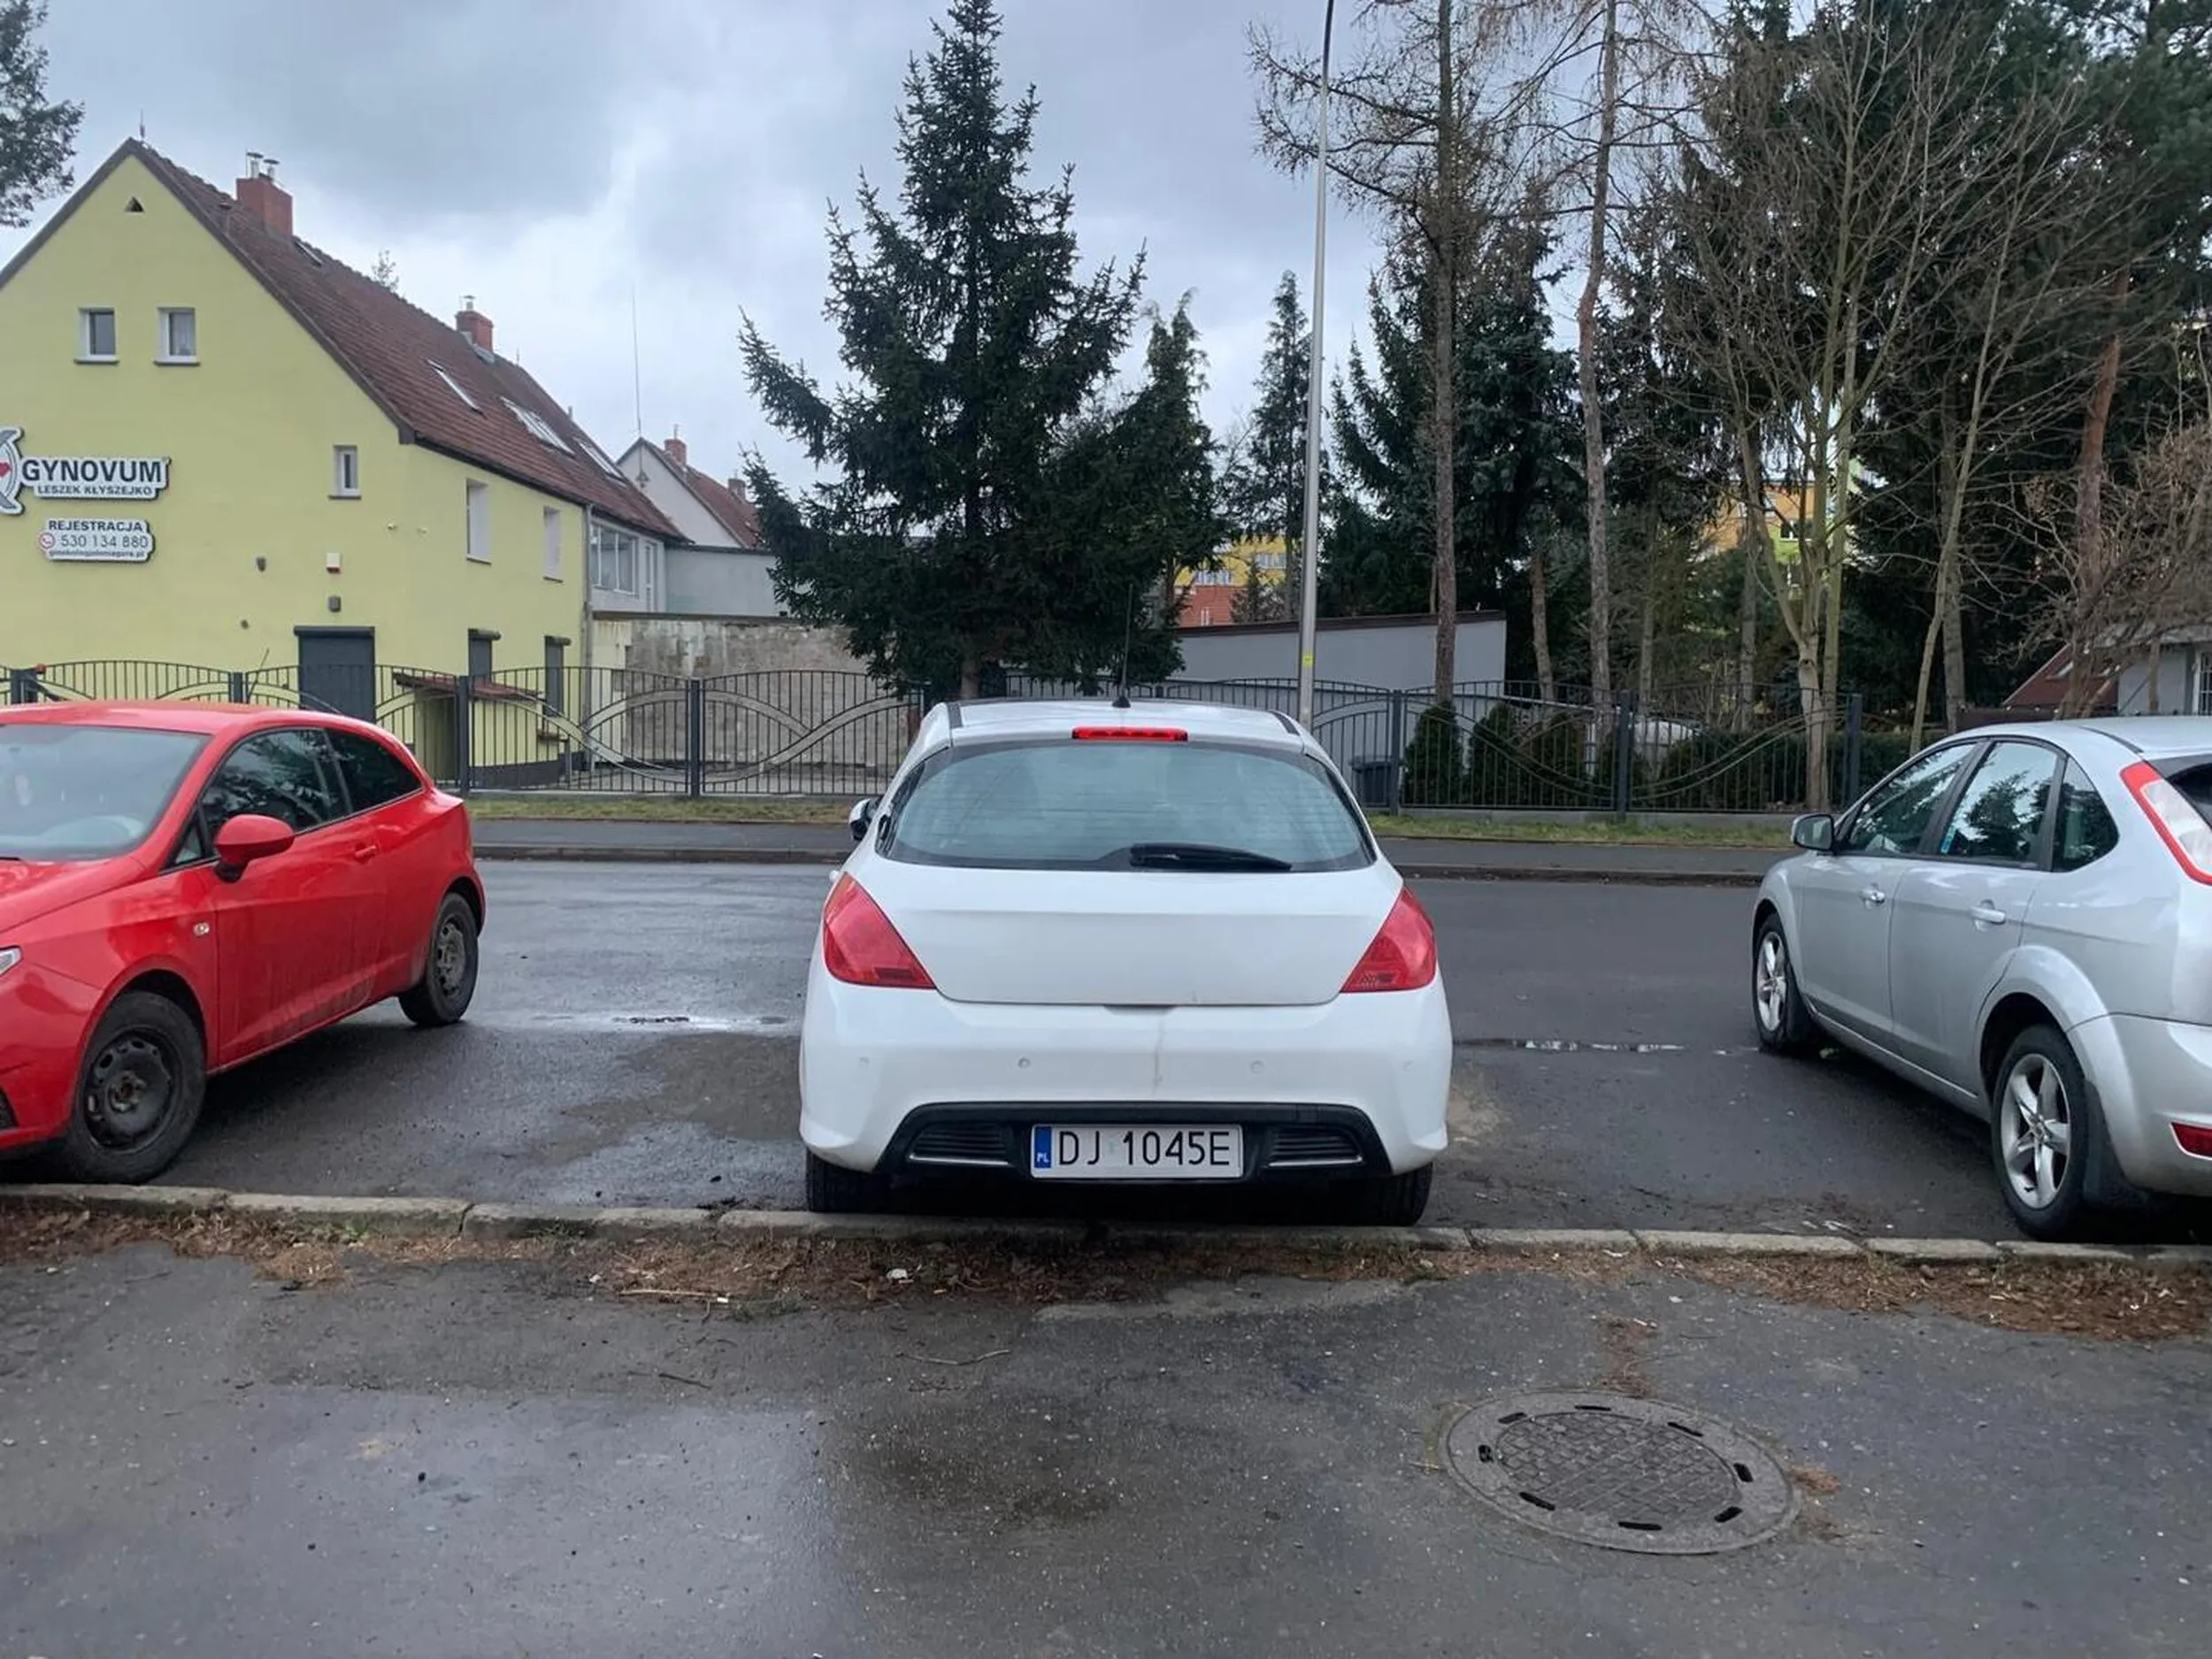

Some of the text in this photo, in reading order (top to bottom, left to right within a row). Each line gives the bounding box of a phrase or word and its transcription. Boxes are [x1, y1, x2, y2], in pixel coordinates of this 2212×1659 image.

[21, 459, 161, 482] GYNOVUM
[38, 486, 81, 495] LESZEK
[49, 520, 142, 531] REJESTRACJA
[60, 534, 149, 548] 530 134 880
[1058, 1131, 1230, 1165] DJ 1045E
[1036, 1152, 1049, 1163] PL
